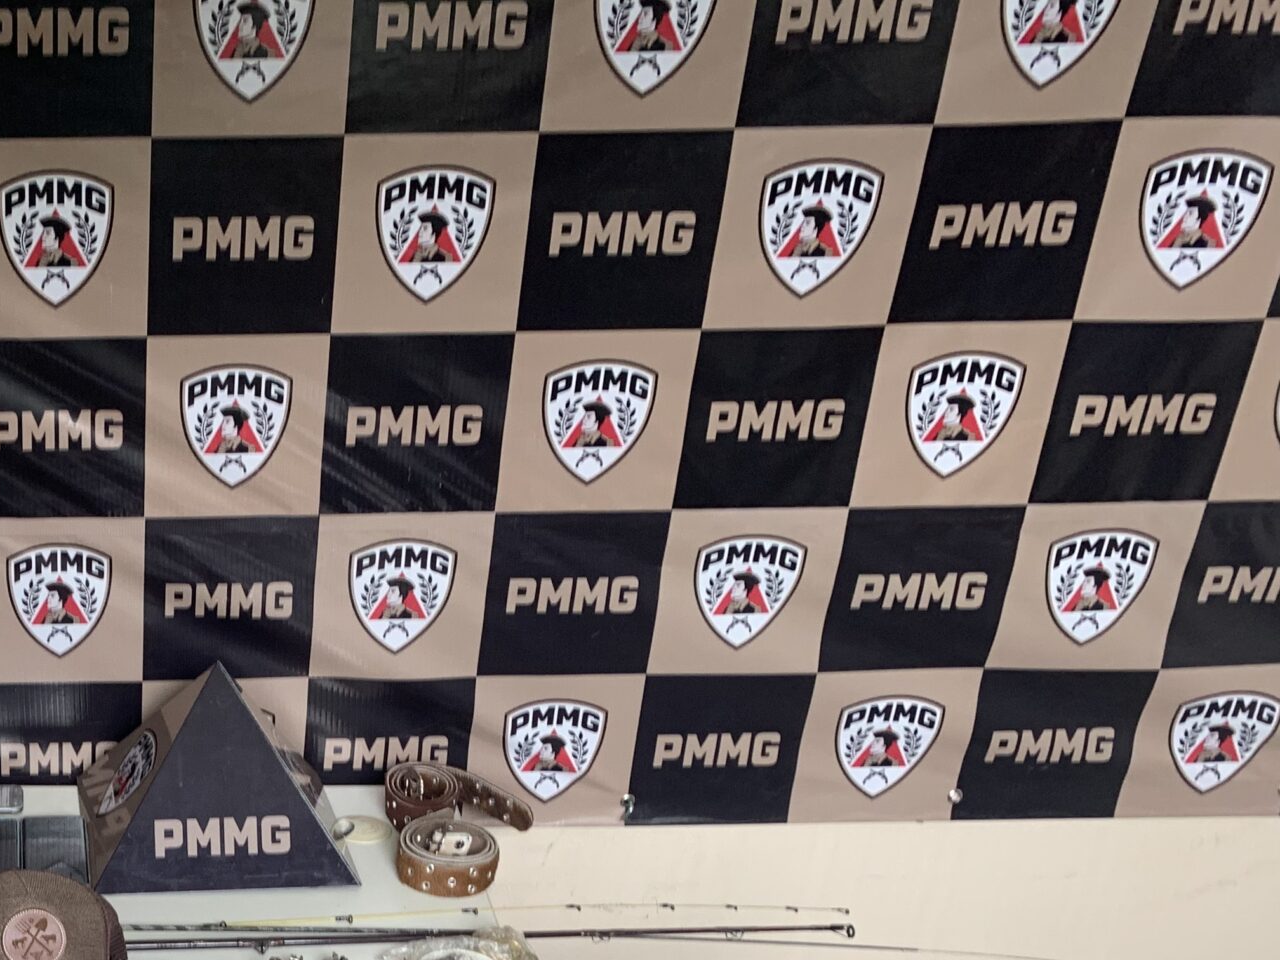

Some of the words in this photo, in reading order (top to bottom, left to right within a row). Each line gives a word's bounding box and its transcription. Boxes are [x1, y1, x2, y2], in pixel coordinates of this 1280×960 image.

[376, 1, 528, 51] PMMG
[776, 0, 933, 42] PMMG
[1173, 0, 1280, 36] PMM
[384, 175, 487, 212] PMMG
[768, 169, 874, 206] PMMG
[1150, 159, 1263, 196] PMMG
[5, 179, 105, 217] PMMG
[173, 216, 314, 260] PMMG
[549, 211, 696, 256] PMMG
[929, 201, 1077, 249] PMMG
[188, 373, 284, 407] PMMG
[550, 369, 649, 402] PMMG
[915, 361, 1016, 395] PMMG
[346, 405, 483, 446] PMMG
[706, 399, 845, 441] PMMG
[1070, 394, 1216, 435] PMMG
[13, 550, 105, 583] PMMG
[356, 547, 449, 577] PMMG
[702, 543, 798, 571] PMMG
[1054, 537, 1150, 568] PMMG
[165, 581, 293, 619] PMMG
[506, 576, 639, 613] PMMG
[851, 572, 987, 609] PMMG
[511, 707, 599, 736] PMMG
[844, 704, 936, 729] PMMG
[1179, 699, 1276, 724] PMMG
[323, 735, 448, 771] PMMG
[653, 732, 780, 767] PMMG
[985, 727, 1114, 762] PMMG
[154, 815, 291, 859] PMMG
